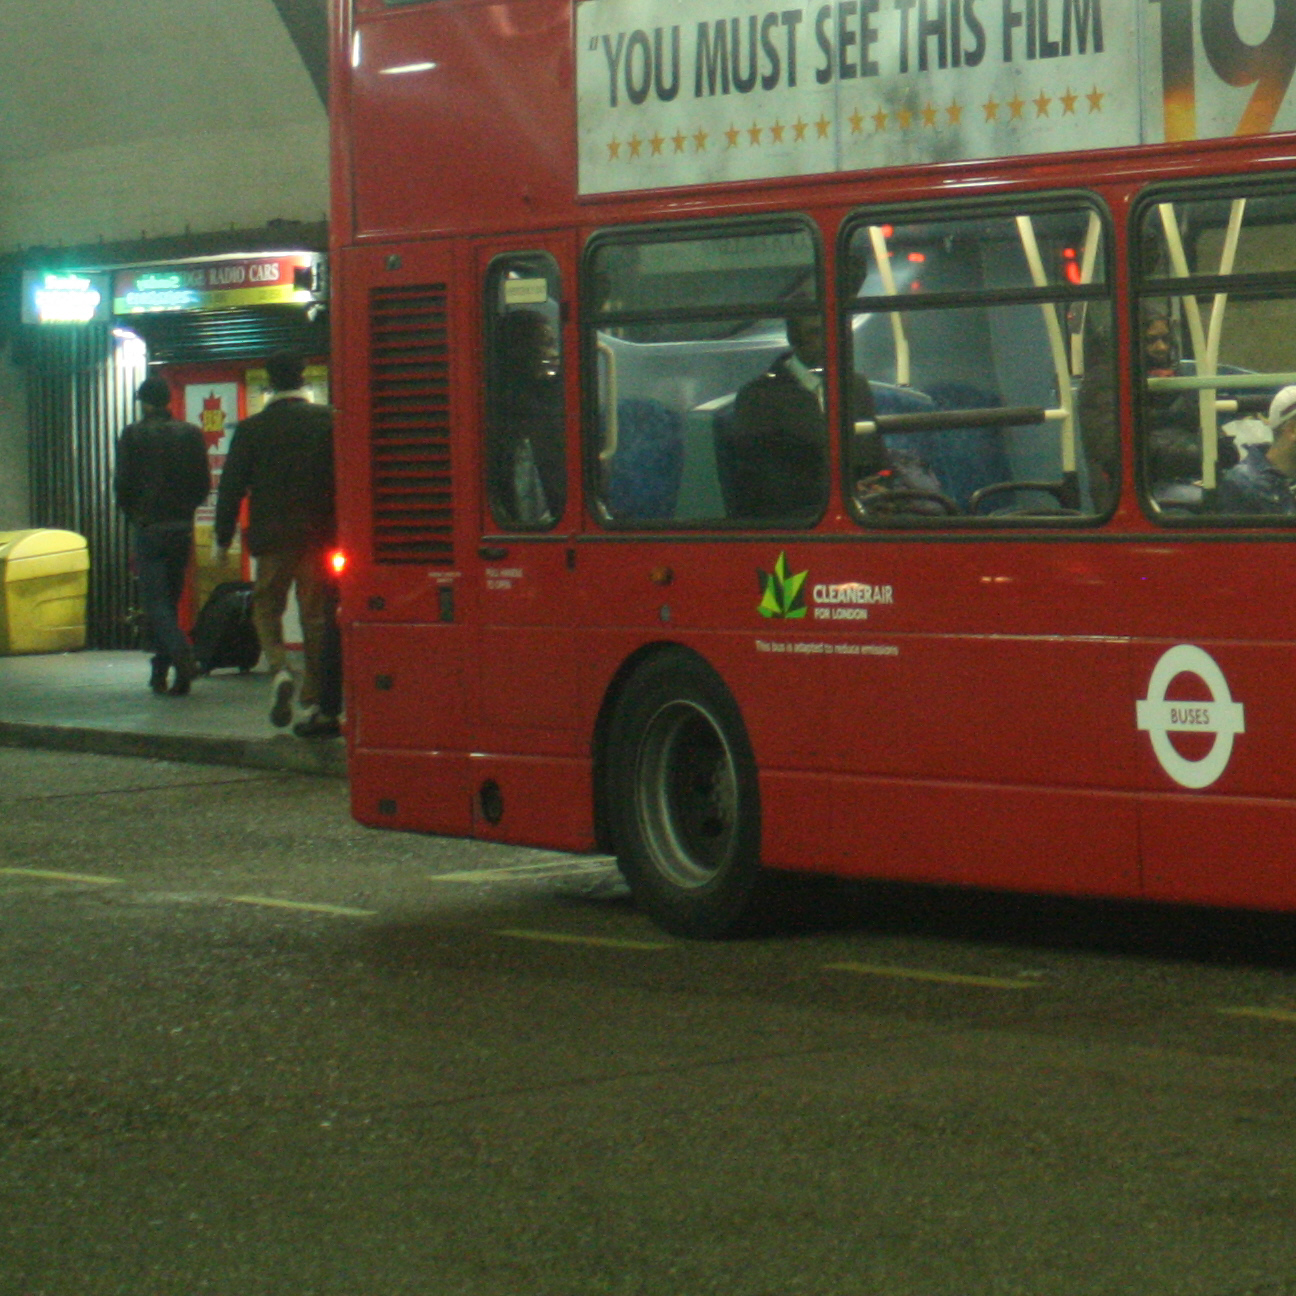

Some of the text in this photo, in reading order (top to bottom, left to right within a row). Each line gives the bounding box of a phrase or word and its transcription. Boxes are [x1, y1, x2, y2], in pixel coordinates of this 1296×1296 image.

[694, 6, 804, 99] MUST
[209, 265, 245, 285] RADIO
[249, 261, 280, 282] CARS
[814, 608, 868, 619] FOR LONDON
[1170, 707, 1210, 726] BUSES
